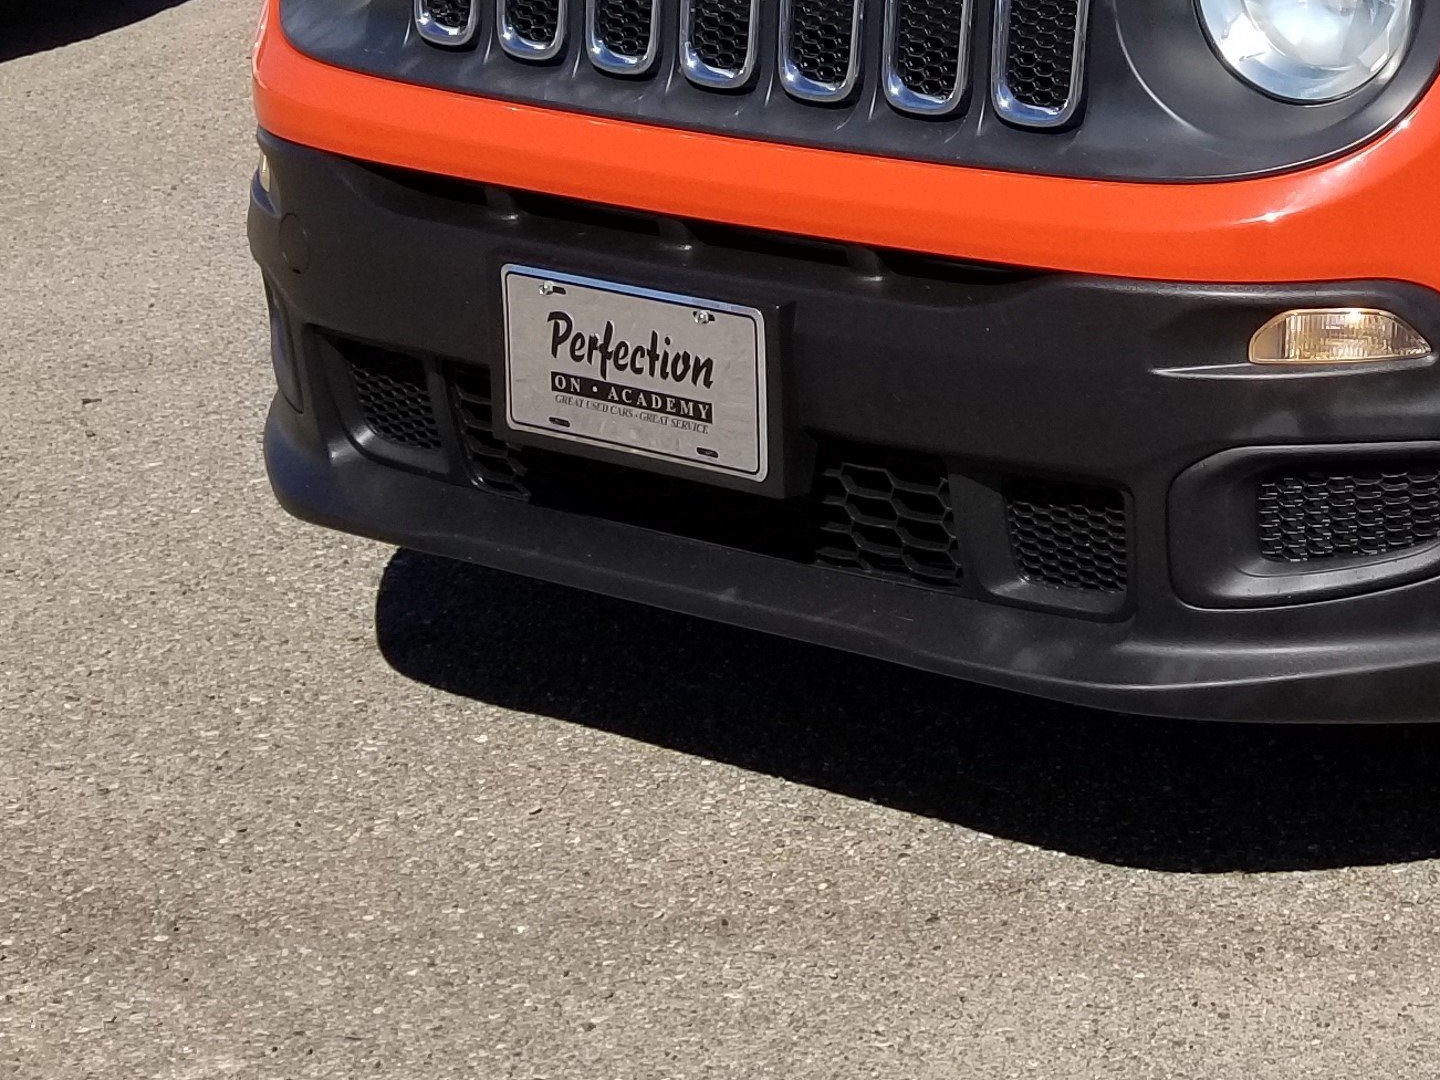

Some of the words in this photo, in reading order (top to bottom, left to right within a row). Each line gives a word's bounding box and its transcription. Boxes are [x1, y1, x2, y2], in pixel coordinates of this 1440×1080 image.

[547, 310, 713, 389] Perfection
[554, 375, 582, 394] ON
[607, 386, 711, 419] ACADEMY
[555, 394, 584, 409] GREAT
[585, 398, 608, 413] USED
[610, 402, 633, 418] CARS
[639, 410, 669, 426] GREAT
[671, 416, 709, 435] SERVICE
